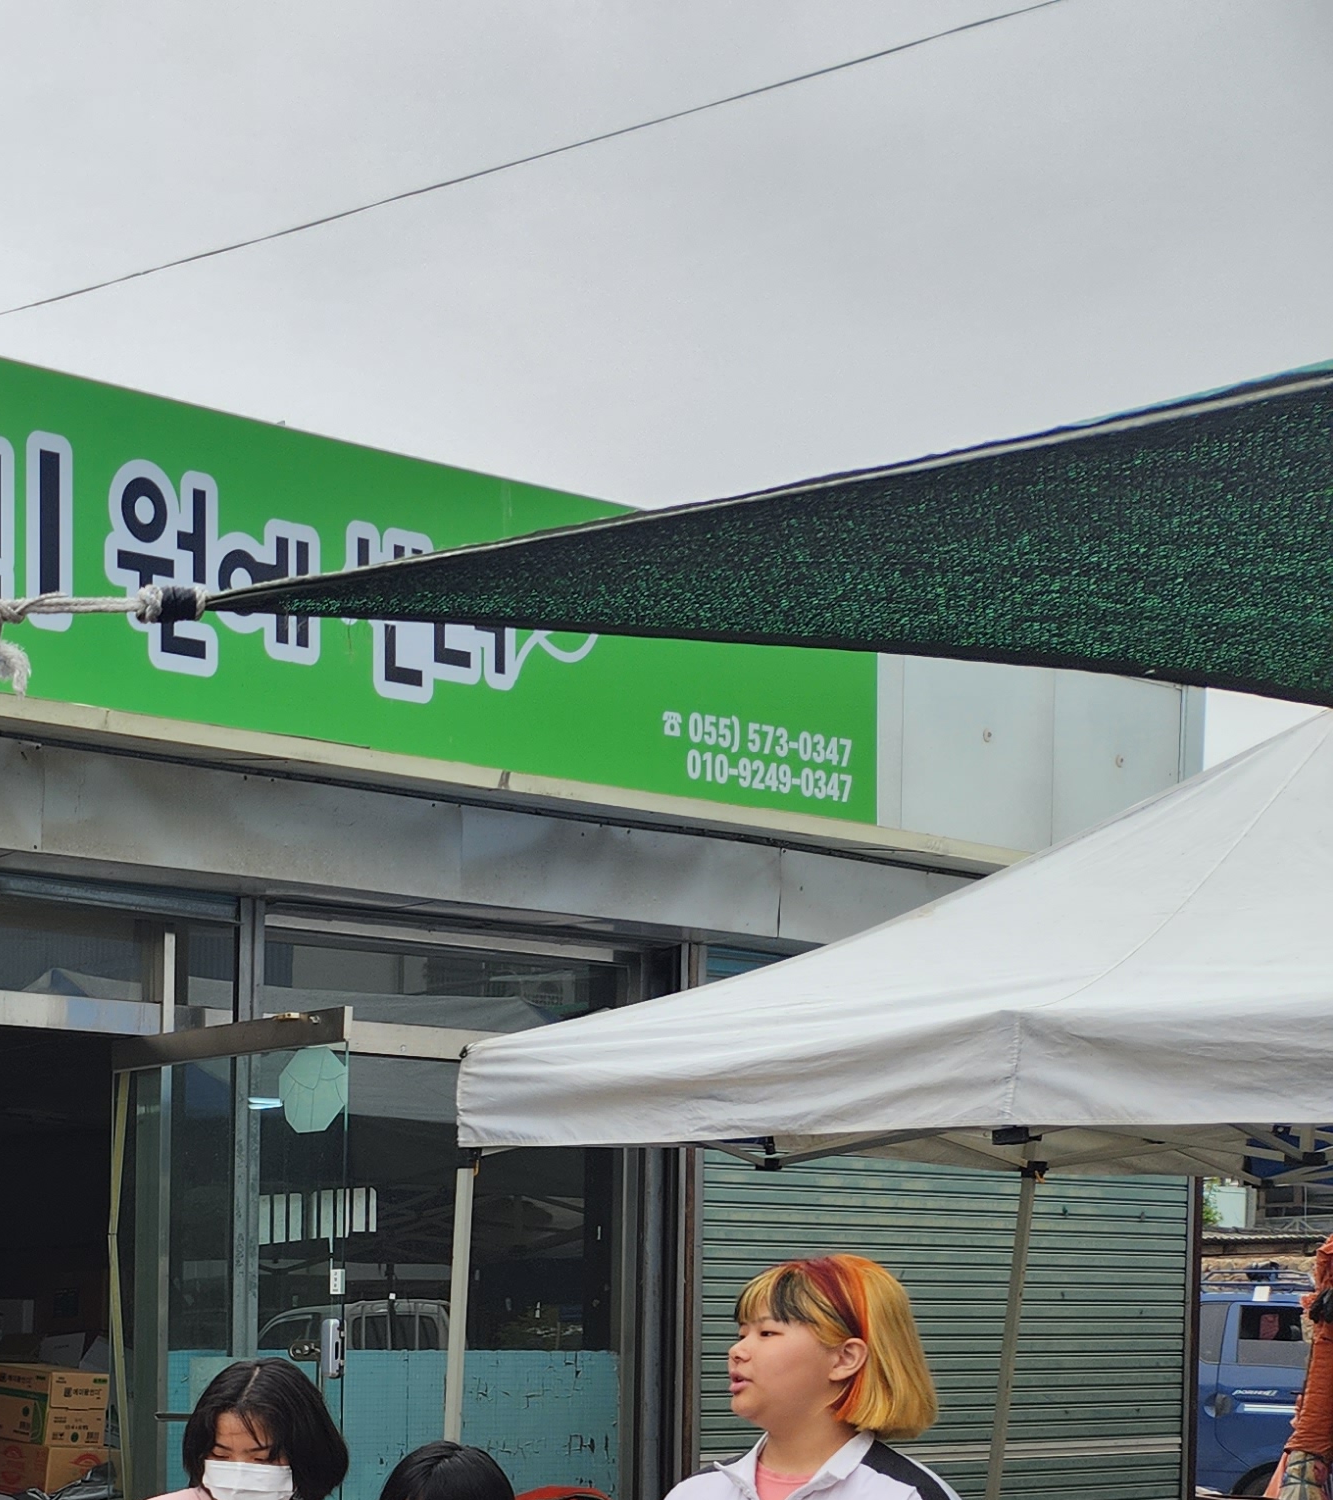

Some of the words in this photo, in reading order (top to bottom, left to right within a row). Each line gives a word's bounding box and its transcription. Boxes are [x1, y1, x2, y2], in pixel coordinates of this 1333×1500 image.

[687, 710, 739, 755] 055)
[747, 720, 853, 768] 573-0347
[686, 751, 853, 803] 010-9249-0347
